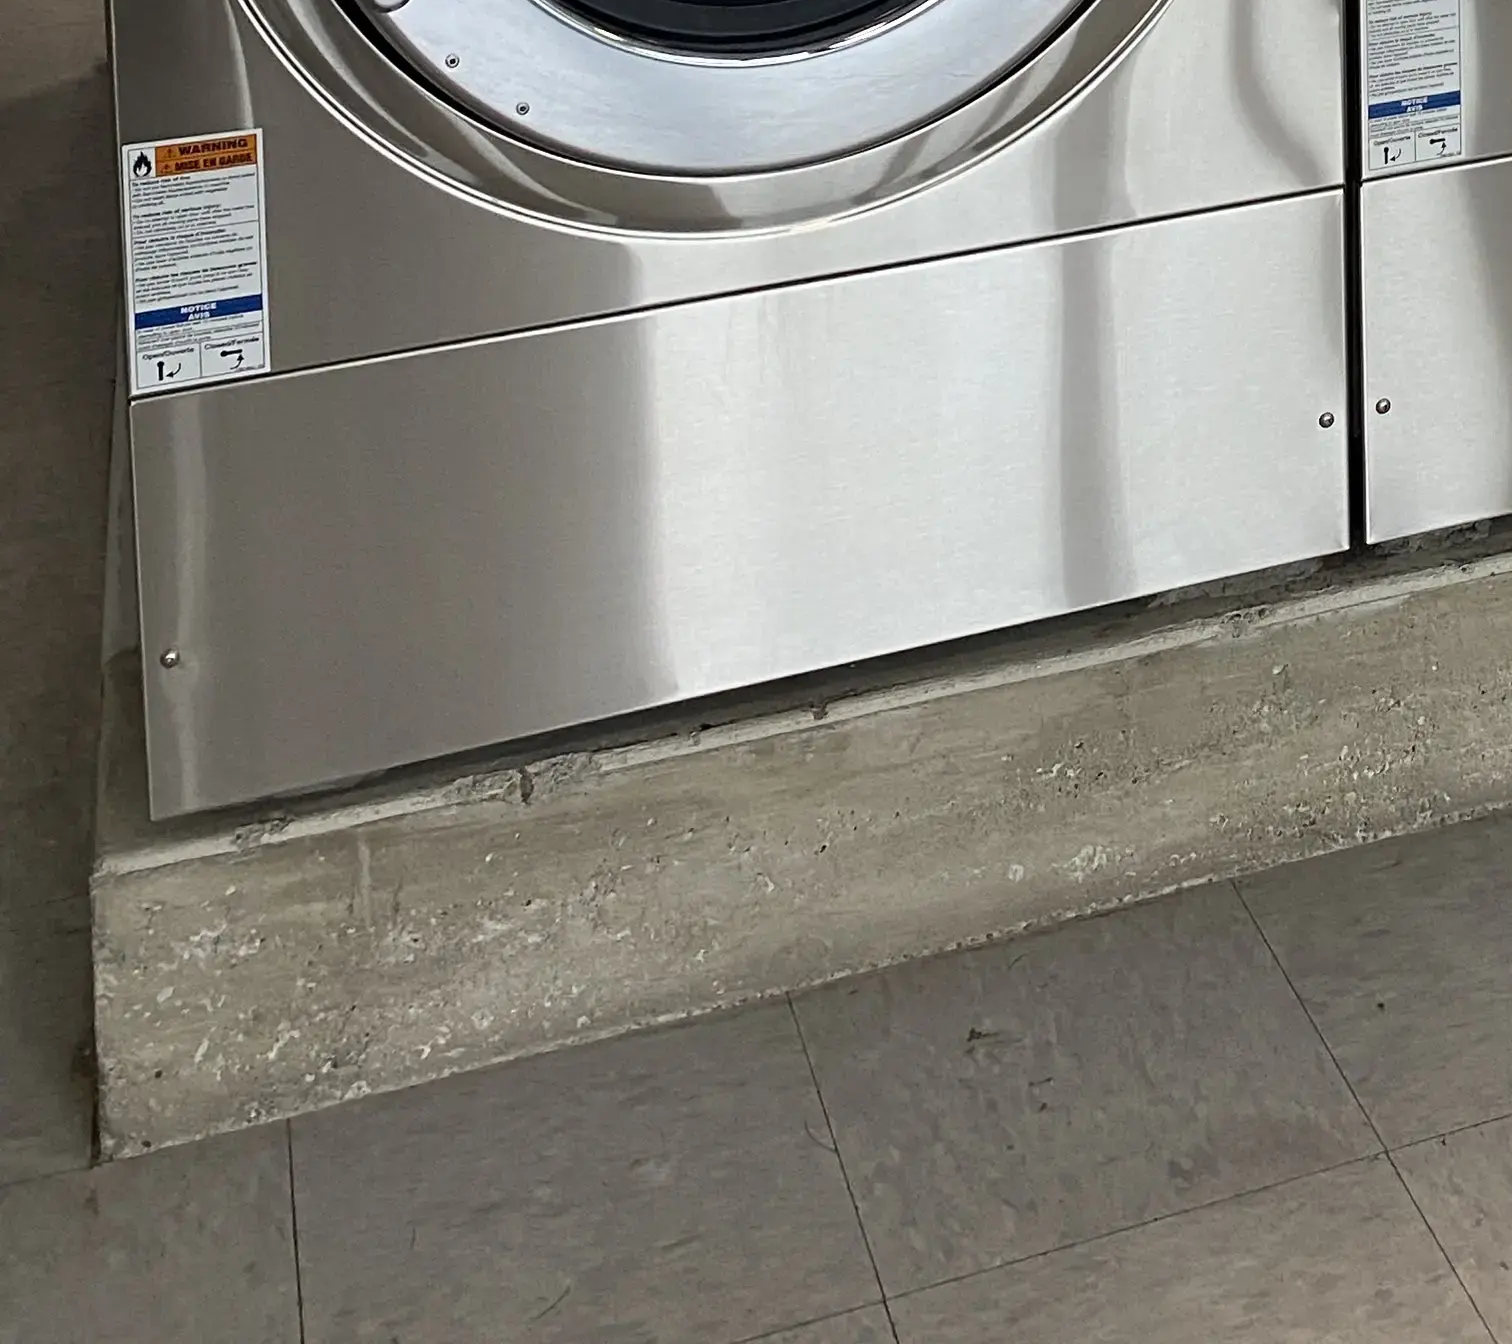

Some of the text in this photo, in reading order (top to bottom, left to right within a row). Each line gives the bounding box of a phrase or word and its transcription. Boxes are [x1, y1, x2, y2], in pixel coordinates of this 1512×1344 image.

[178, 139, 248, 156] WARNING
[174, 153, 253, 171] MISE EN GARDE
[180, 302, 217, 314] NOTICE
[188, 311, 211, 320] AVIS
